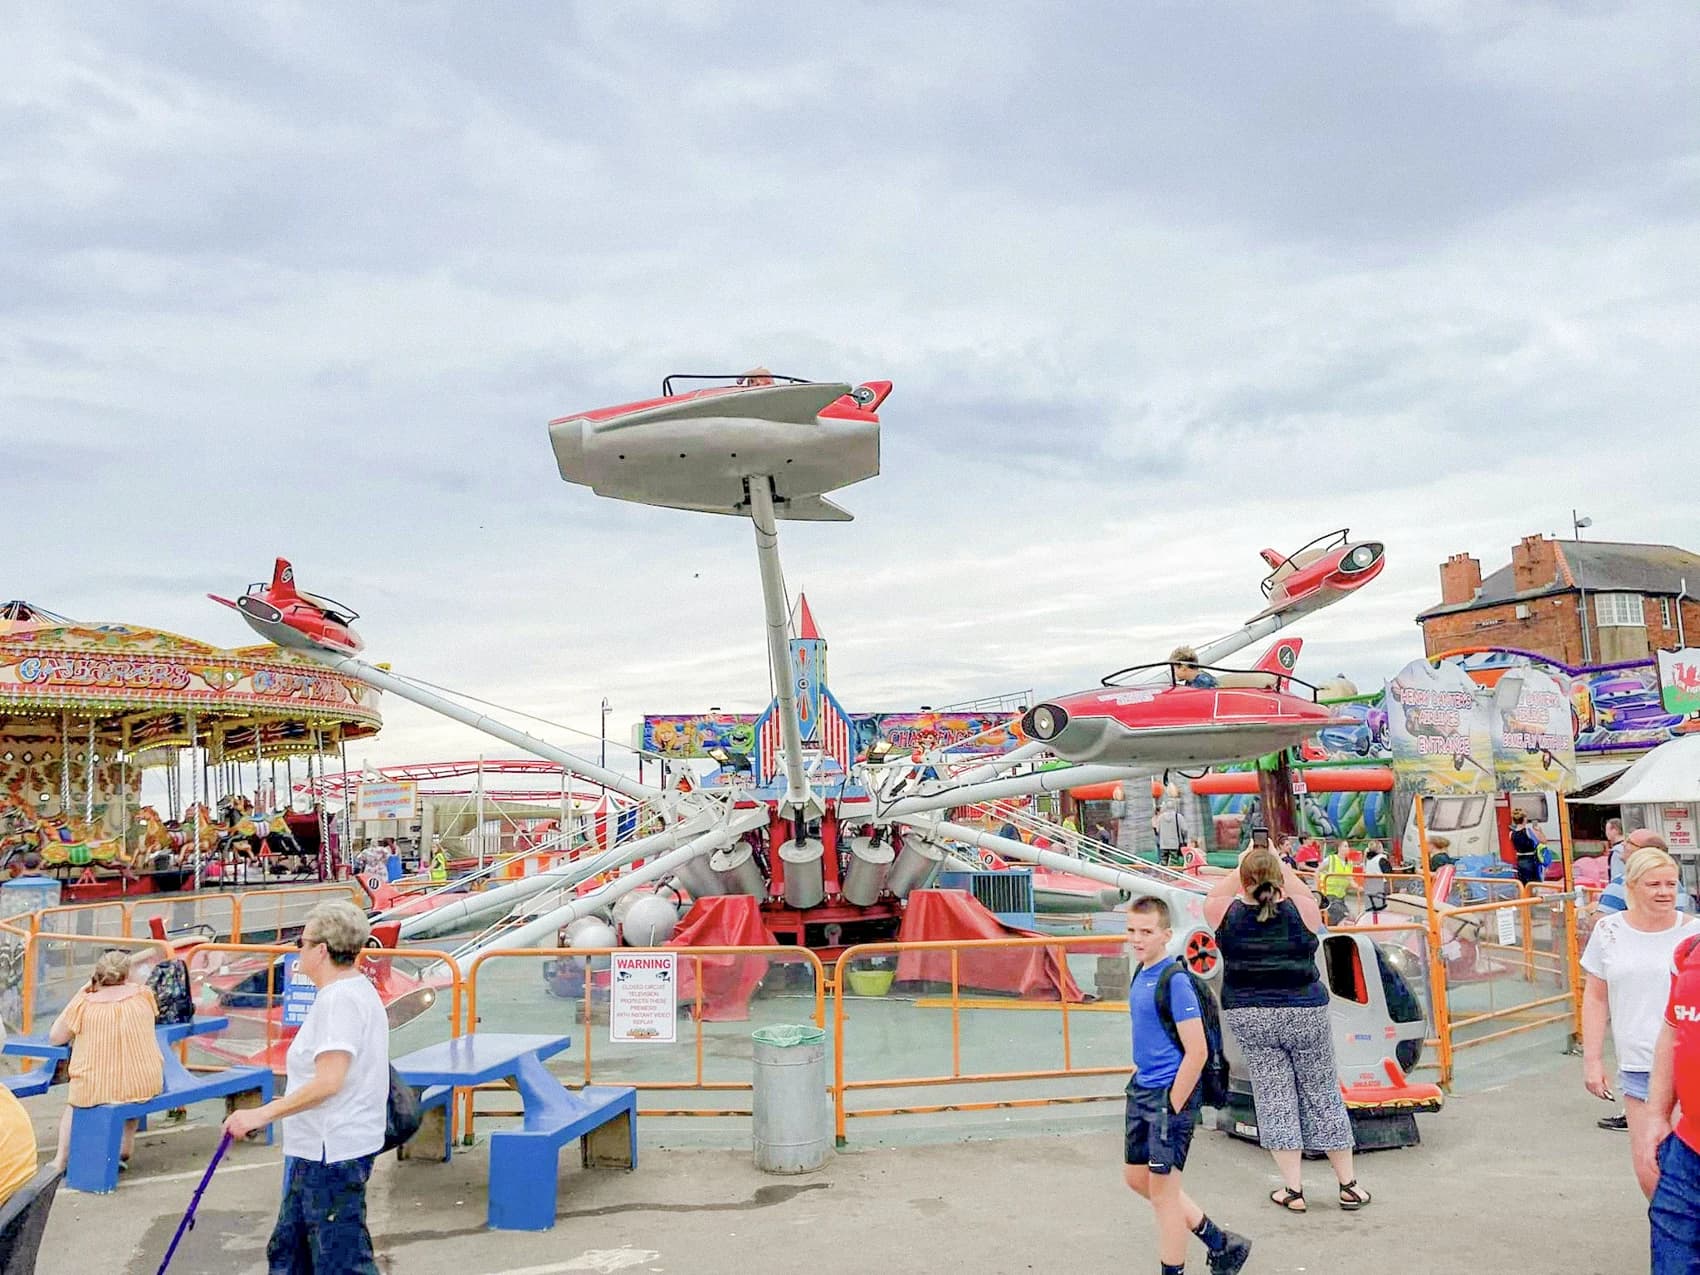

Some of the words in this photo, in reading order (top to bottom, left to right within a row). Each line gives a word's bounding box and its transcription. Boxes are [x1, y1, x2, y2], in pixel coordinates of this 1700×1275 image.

[1282, 650, 1292, 665] 4
[17, 656, 190, 689] GALLOPERS
[1418, 735, 1471, 755] ENTRANCE
[616, 959, 671, 969] WARNING
